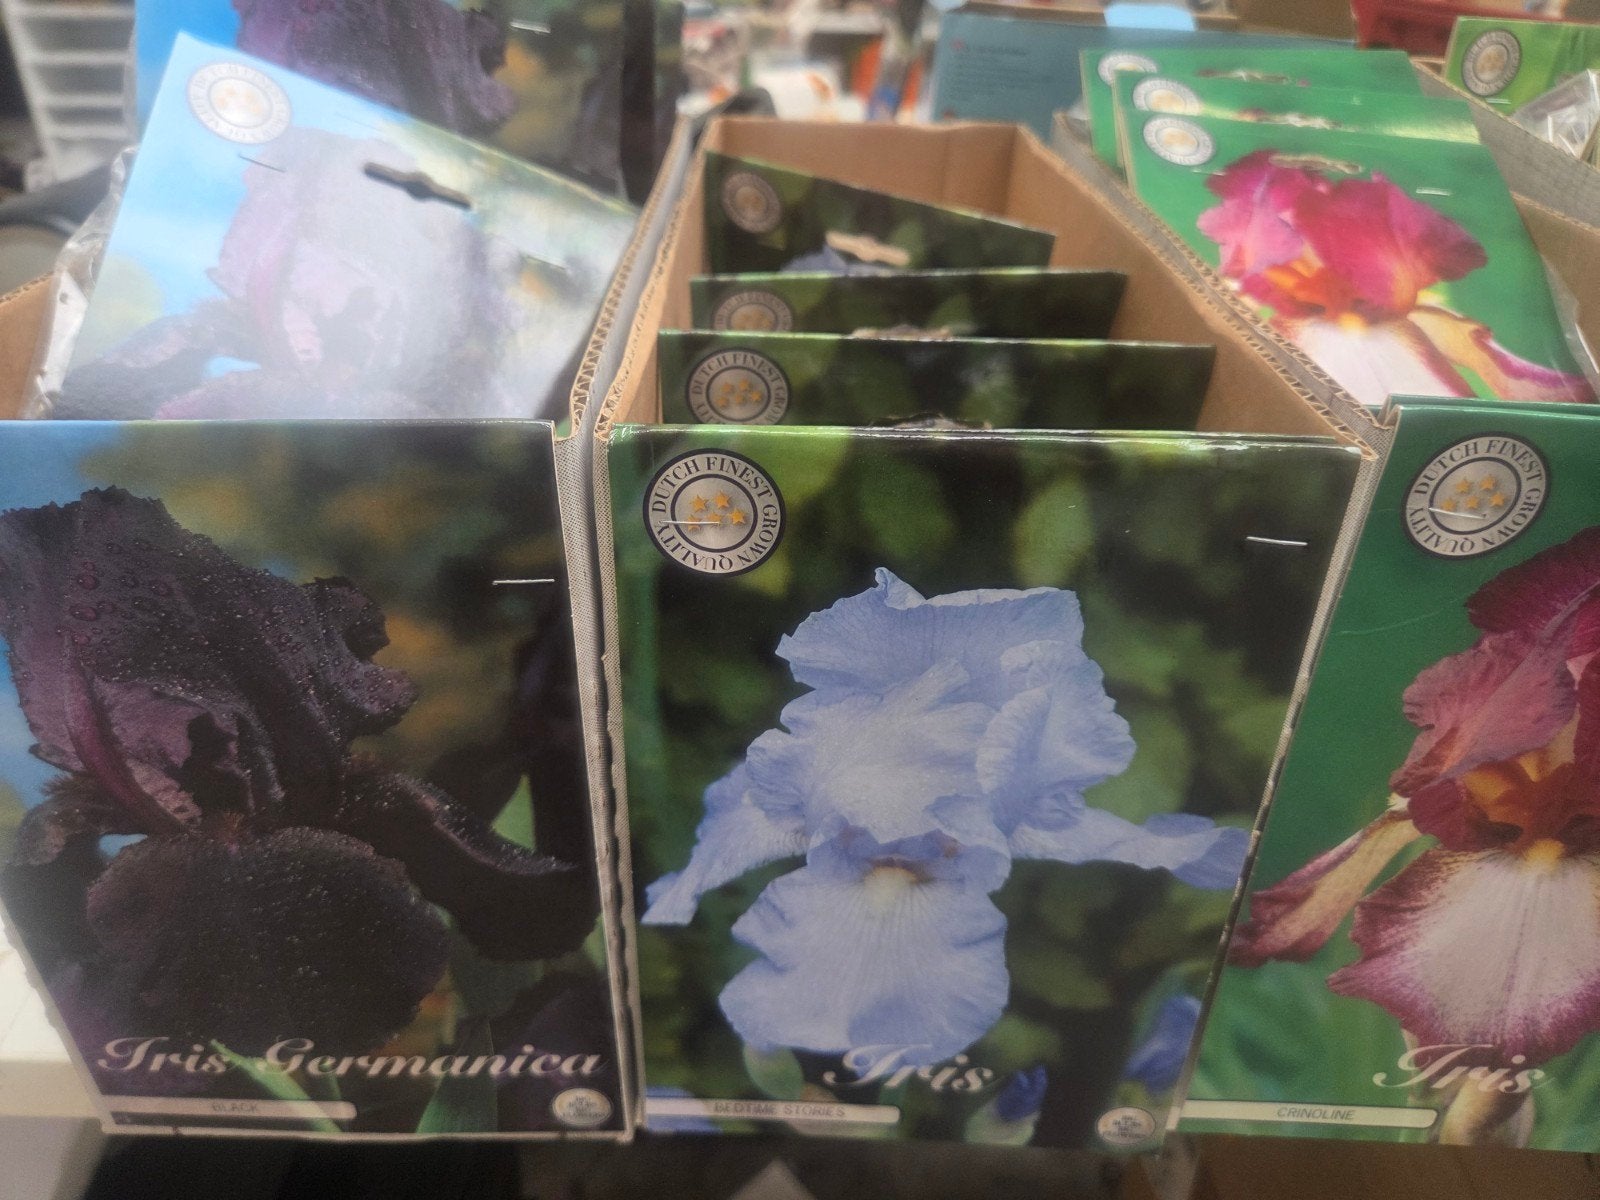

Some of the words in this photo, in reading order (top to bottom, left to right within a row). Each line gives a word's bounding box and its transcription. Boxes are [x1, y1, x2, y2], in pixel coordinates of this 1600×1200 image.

[705, 456, 773, 498] FINEST
[1414, 441, 1478, 495] DUTCH
[1484, 439, 1543, 482] FINEST
[651, 457, 700, 514] DUTCH
[736, 503, 778, 566] GROWN
[1408, 506, 1475, 553] QUALITY
[1481, 489, 1542, 546] GROWN
[654, 519, 734, 571] QUALITY
[97, 1036, 236, 1074] Iris
[255, 1034, 606, 1077] Germanica
[822, 1043, 995, 1093] Iris
[1372, 1043, 1550, 1094] Iris
[212, 1102, 257, 1113] BLACK
[714, 1102, 776, 1114] BEDTIME
[784, 1104, 846, 1117] STORIES
[1277, 1106, 1356, 1121] CRINOLINE
